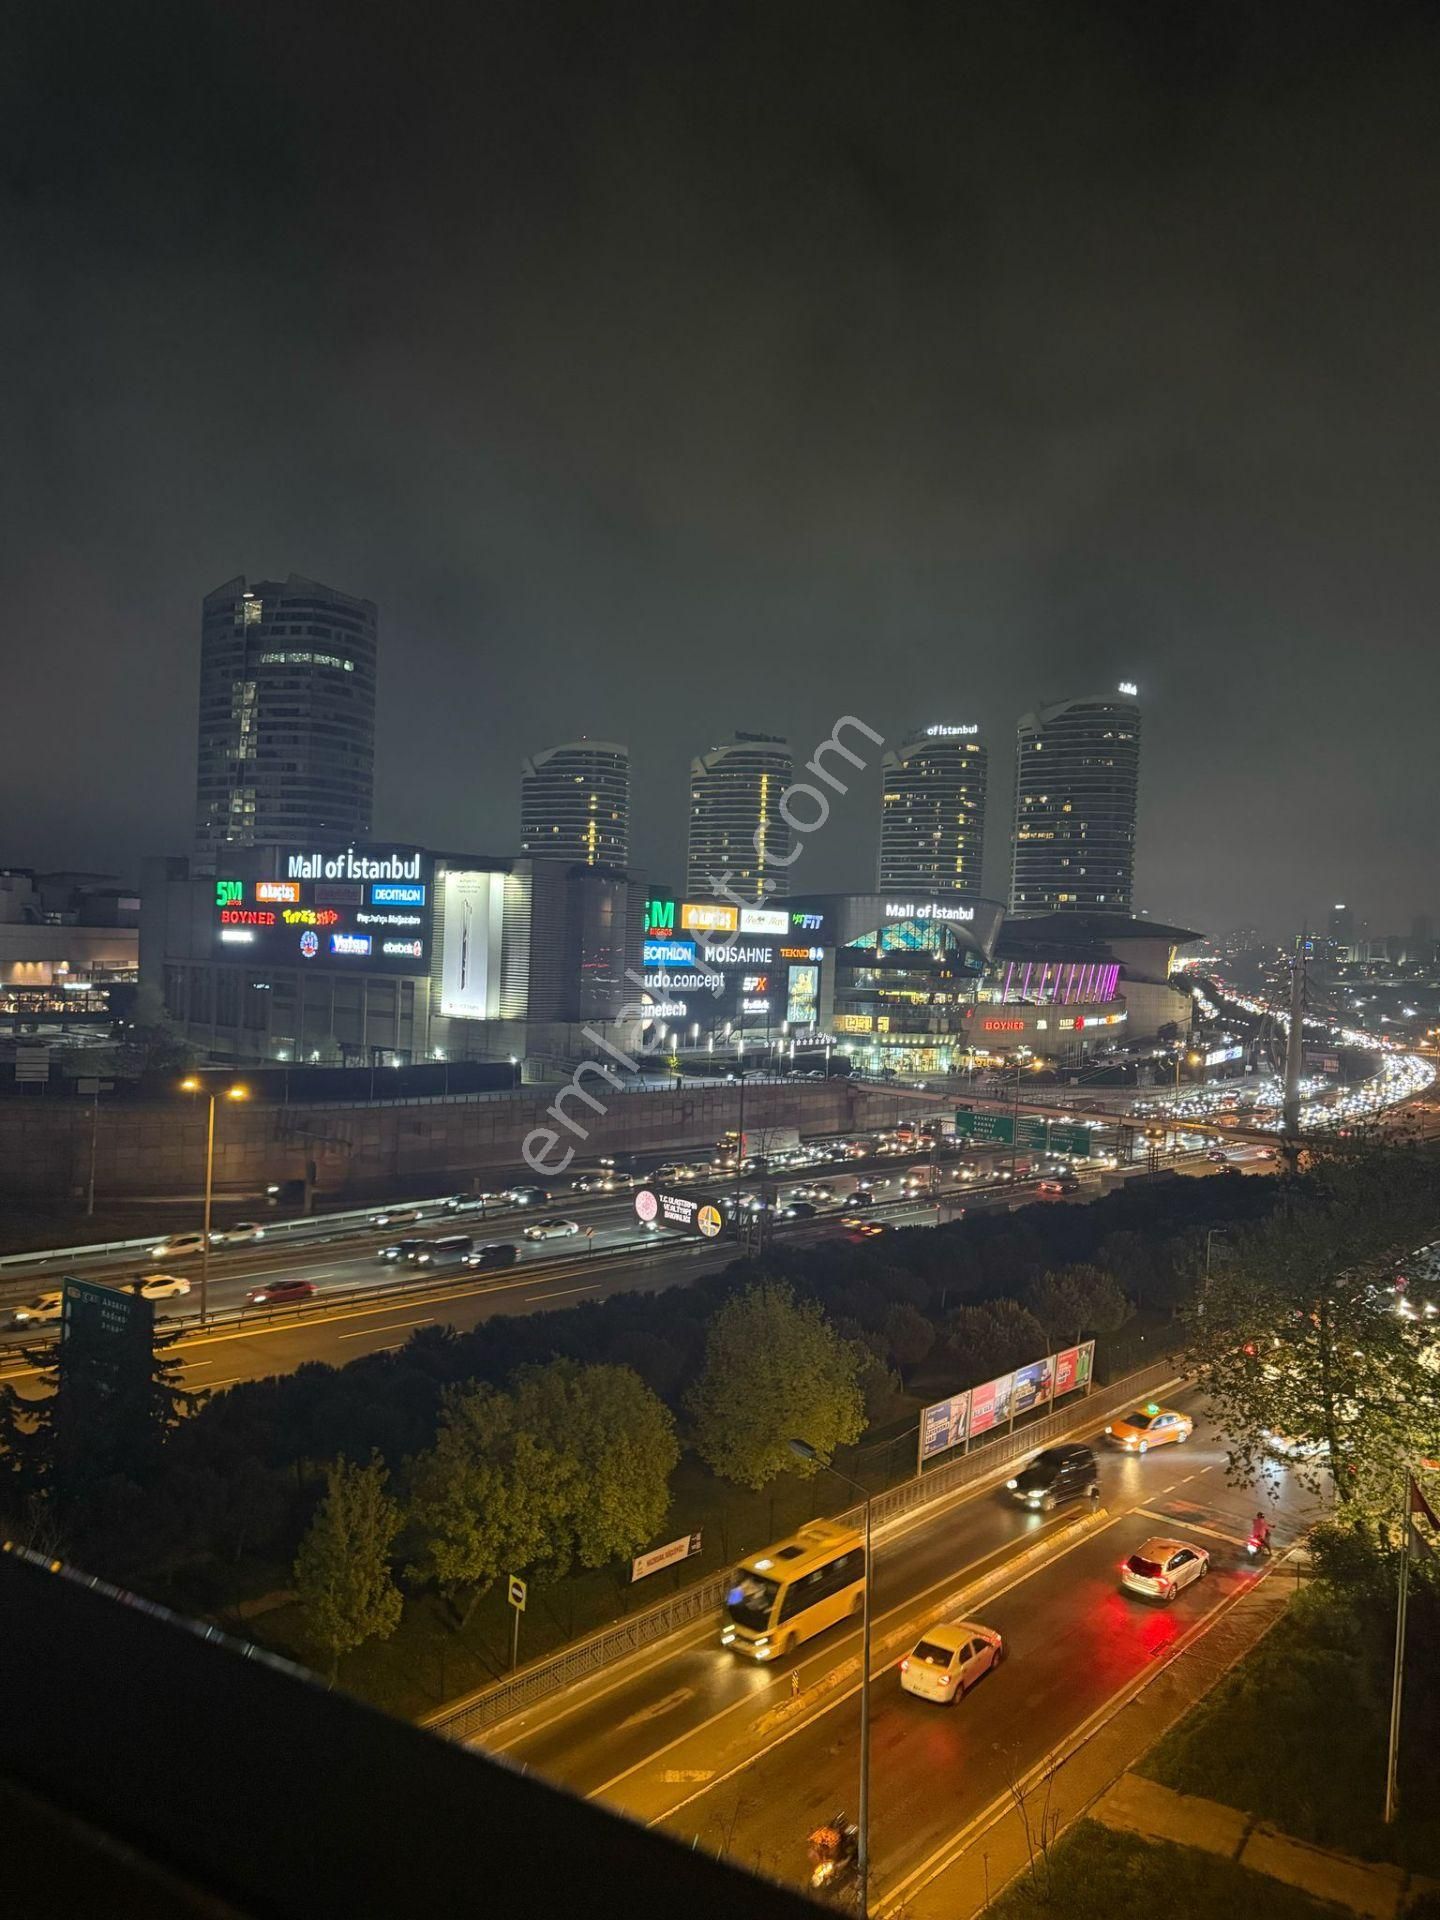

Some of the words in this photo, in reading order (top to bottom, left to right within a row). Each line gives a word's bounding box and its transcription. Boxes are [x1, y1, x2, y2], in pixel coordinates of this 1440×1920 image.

[288, 854, 322, 879] Mall
[325, 855, 346, 879] of
[216, 881, 243, 906] 5M
[375, 889, 421, 901] DECATHLON
[221, 911, 276, 925] BOYNER
[886, 904, 915, 917] Mall
[917, 904, 932, 918] of
[644, 971, 725, 991] udo.concept
